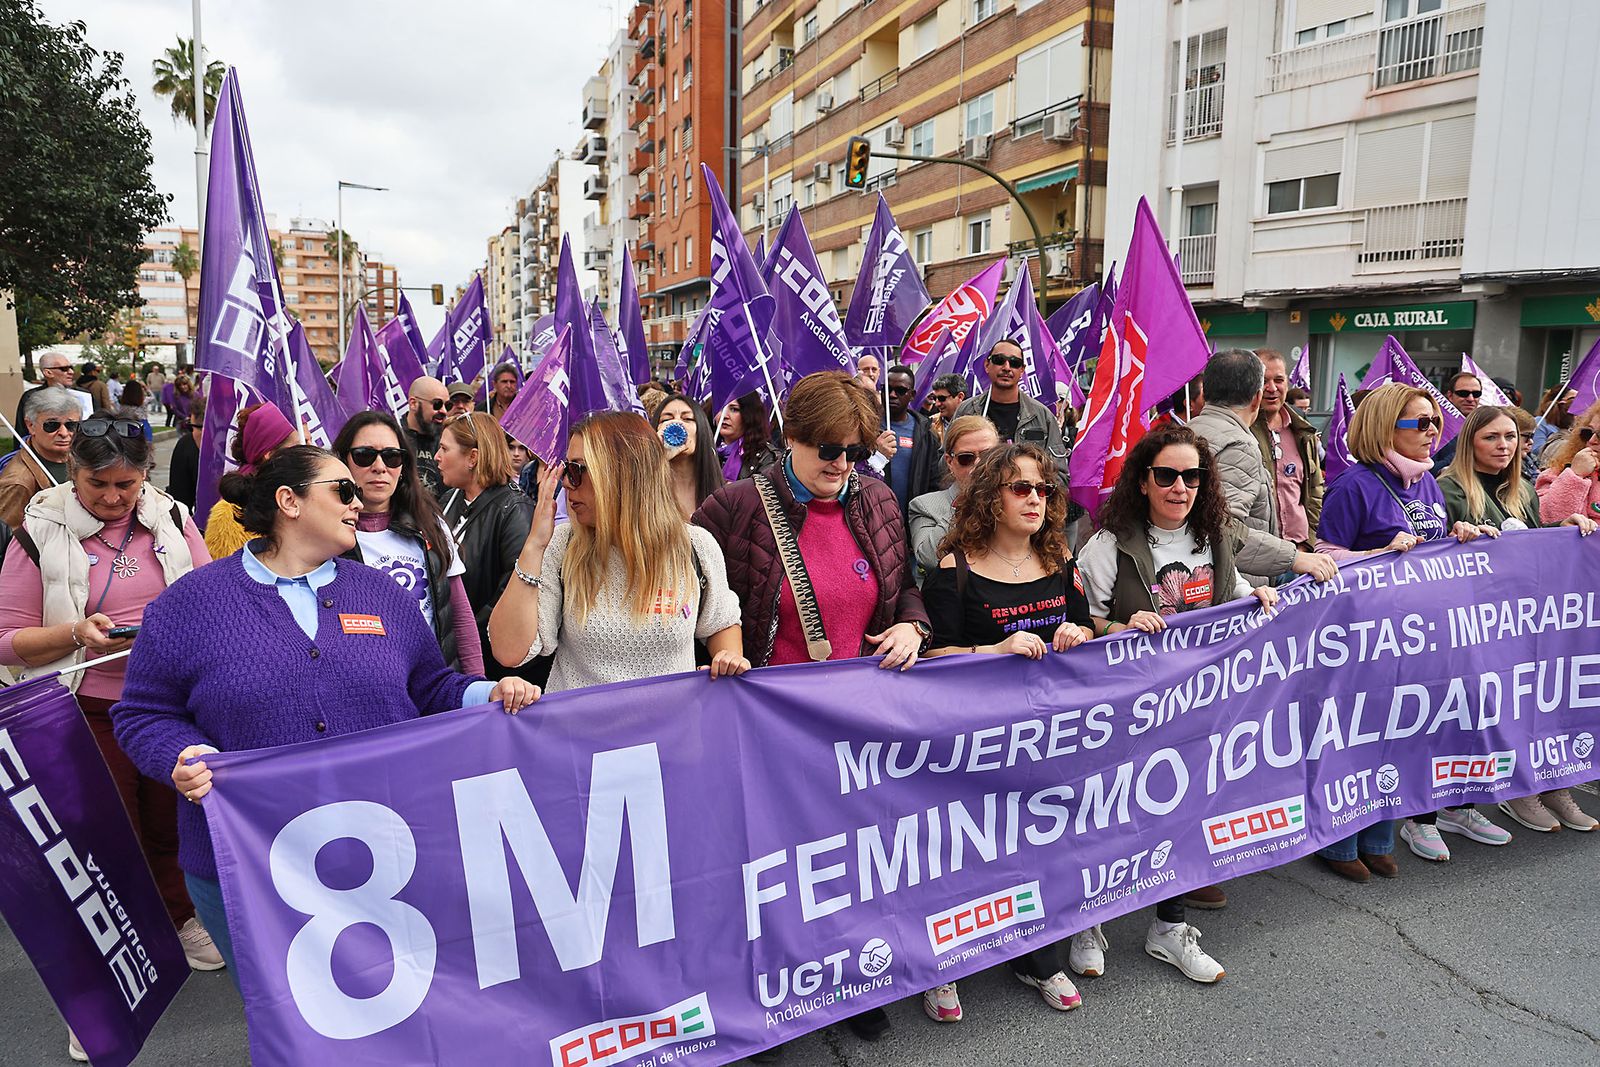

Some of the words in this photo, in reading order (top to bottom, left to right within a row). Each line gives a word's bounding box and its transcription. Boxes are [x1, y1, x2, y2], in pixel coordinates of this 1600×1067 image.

[800, 311, 848, 366] Andalucía
[1354, 313, 1391, 328] CAJA
[1393, 310, 1448, 326] RURAL
[1560, 349, 1571, 385] RURAL
[1106, 633, 1156, 666] DÍA
[1162, 571, 1350, 653] INTERNAIONAL
[1354, 564, 1388, 591] DE
[1391, 560, 1421, 586] LA
[1420, 551, 1494, 581] MUJER
[833, 703, 1114, 795] MUJERES
[1128, 613, 1438, 737] SINDICALISTAS:
[1529, 734, 1570, 769] UGT
[742, 747, 1190, 942] FEMINISMO
[1206, 670, 1502, 796] IGUALDAD
[1324, 768, 1372, 813] UGT
[1081, 848, 1150, 899] UGT
[1212, 854, 1235, 868] unión
[1236, 842, 1278, 863] provincial
[1279, 840, 1289, 850] de
[269, 742, 676, 1040] 8M
[1079, 885, 1132, 913] Andalucía
[1135, 869, 1177, 892] Huelva
[937, 953, 961, 971] unión
[961, 936, 1003, 962] provincial
[1003, 933, 1014, 945] de
[1014, 923, 1046, 939] Huelva
[758, 948, 851, 1008] UGT
[765, 992, 835, 1029] Andalucía
[841, 974, 893, 1001] Huelva
[659, 1049, 675, 1065] de
[674, 1039, 716, 1059] Huelva
